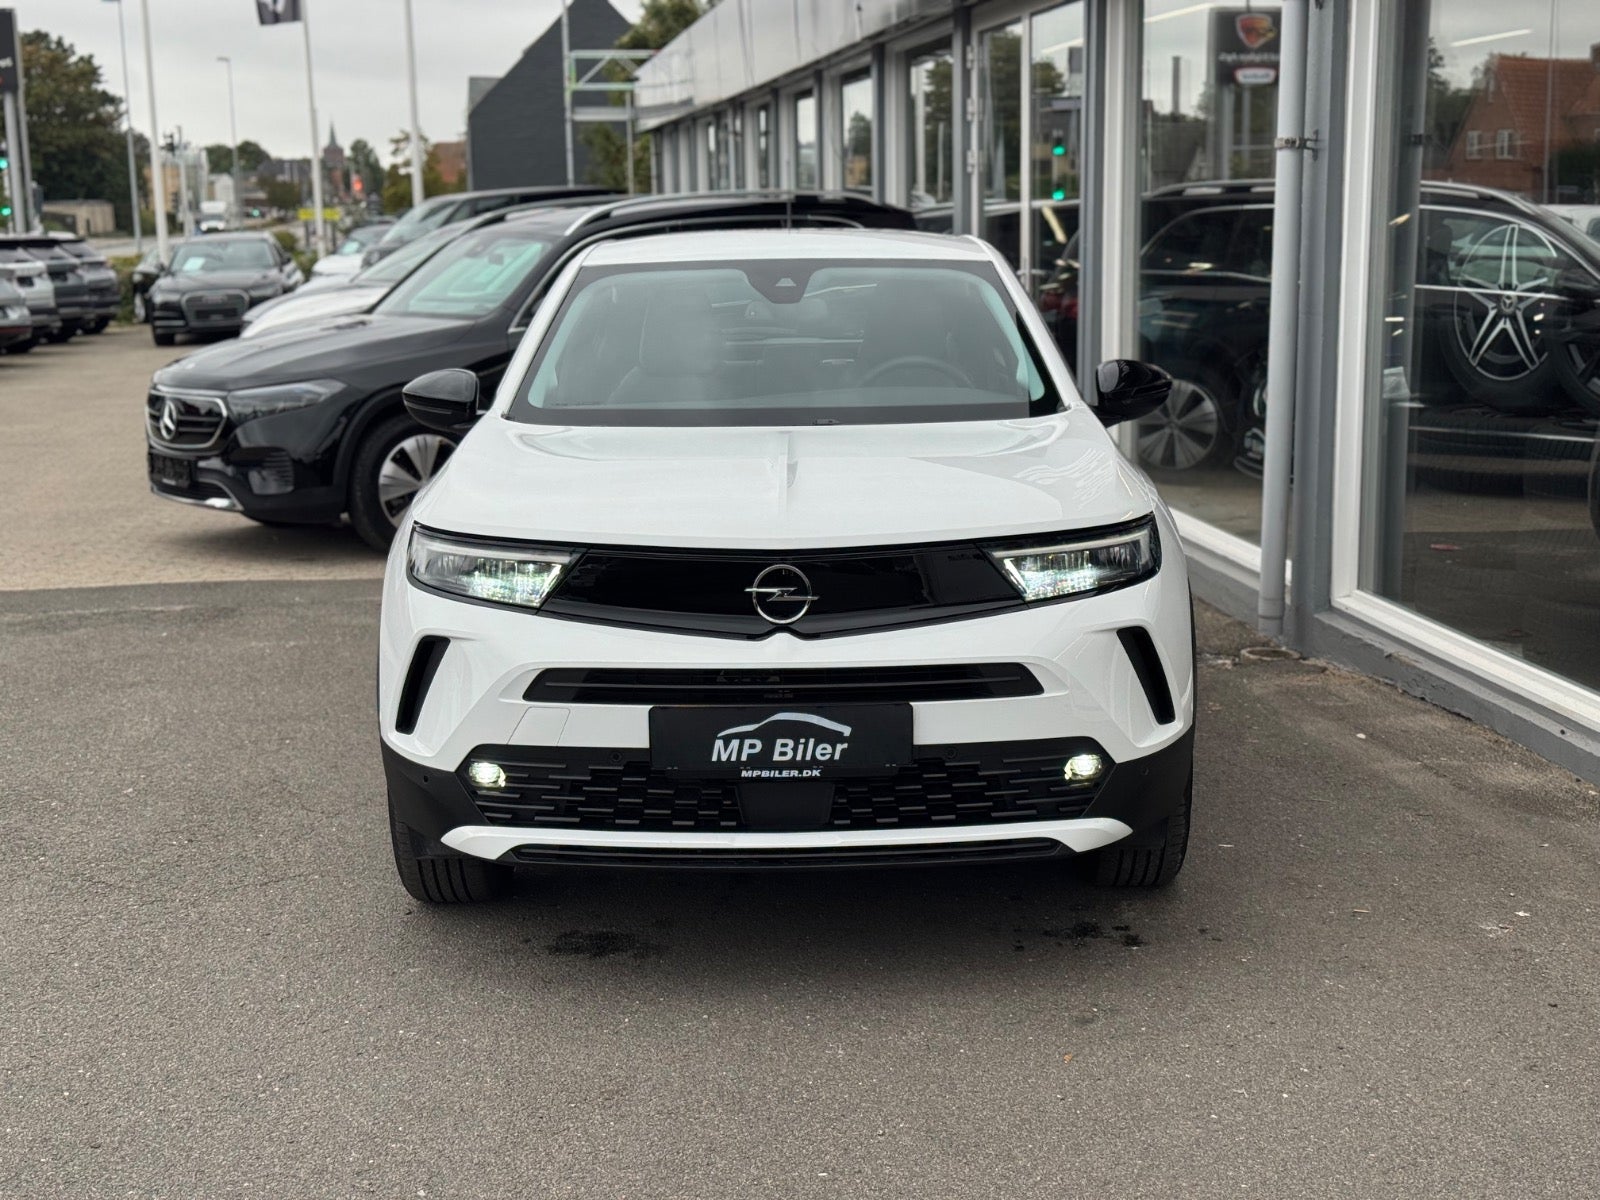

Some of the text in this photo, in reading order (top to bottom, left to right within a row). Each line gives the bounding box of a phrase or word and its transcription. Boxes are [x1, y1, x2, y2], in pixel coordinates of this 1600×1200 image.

[711, 737, 848, 762] MP Biler
[740, 768, 822, 778] MPBILER.DK
